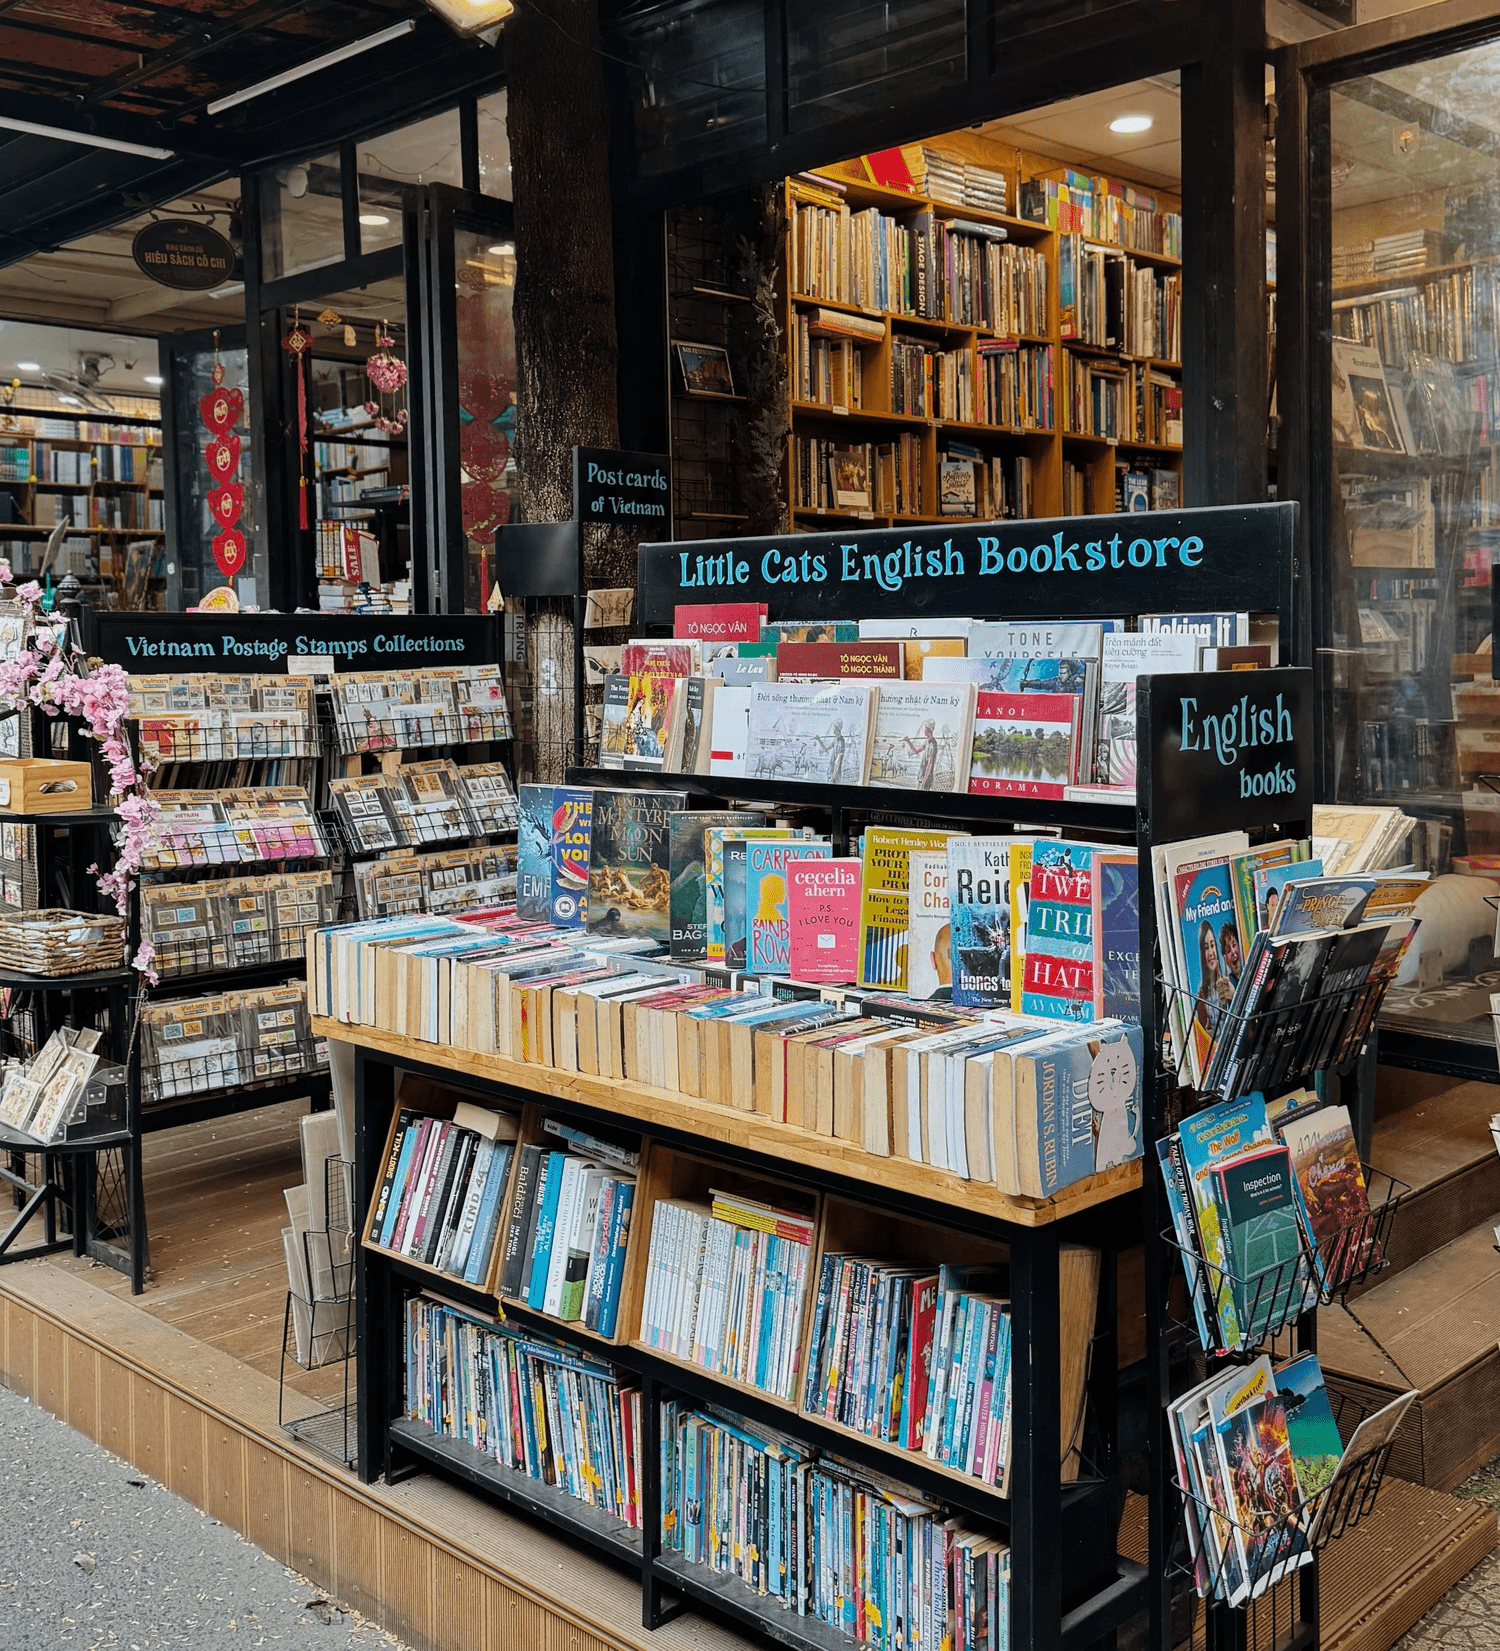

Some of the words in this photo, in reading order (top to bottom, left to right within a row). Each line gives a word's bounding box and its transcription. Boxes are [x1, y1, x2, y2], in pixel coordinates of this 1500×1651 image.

[917, 236, 926, 269] STAGE
[918, 271, 927, 311] DESIGN
[587, 462, 668, 491] Postcards
[591, 496, 605, 513] of
[608, 496, 666, 516] Vietnam
[346, 544, 360, 576] SALE
[679, 552, 750, 587] Little
[760, 548, 829, 584] Cats
[840, 539, 965, 592] English
[977, 531, 1204, 577] Bookstore
[516, 615, 525, 661] TRUNG
[687, 623, 699, 634] TÔ
[700, 624, 726, 634] NGỌC
[728, 621, 747, 633] VÂN
[1008, 632, 1053, 646] TONE
[1217, 617, 1231, 646] It
[125, 636, 216, 657] Vietnam
[222, 636, 288, 661] Postage
[295, 635, 368, 660] Stamps
[373, 634, 466, 653] Collections
[840, 653, 849, 663] TÔ
[850, 654, 872, 664] NGỌC
[873, 653, 888, 663] VÂN
[840, 664, 849, 673] TÔ
[850, 665, 872, 675] NGỌC
[873, 664, 896, 673] THÀNH
[930, 695, 948, 705] Nam
[1179, 692, 1294, 766] English
[1239, 762, 1297, 799] books
[563, 801, 592, 814] THE
[612, 796, 646, 808] VONDA
[611, 828, 663, 844] MOON
[873, 835, 898, 845] Robert
[901, 837, 928, 849] Henley
[618, 846, 653, 862] SUN
[871, 860, 903, 869] YOUR
[795, 868, 856, 885] cecelia
[805, 884, 846, 897] ahern
[869, 895, 890, 903] How
[893, 896, 903, 904] to
[805, 916, 830, 924] LOVE
[834, 916, 853, 927] YOU
[1186, 907, 1197, 923] My
[1197, 898, 1220, 918] Friend
[1072, 942, 1092, 964] of
[960, 970, 998, 991] bones
[1042, 1061, 1055, 1123] JORDAN
[1071, 1077, 1092, 1146] DIET
[1209, 1142, 1222, 1155] The
[1223, 1130, 1240, 1148] Wolf
[1044, 1138, 1057, 1189] RUBIN
[1171, 1144, 1181, 1167] TALES
[1176, 1167, 1183, 1177] OF
[1196, 1167, 1209, 1181] and
[1243, 1173, 1281, 1192] Inspection
[1308, 1157, 1347, 1187] Chance
[512, 1166, 529, 1218] Baldacci
[1178, 1177, 1186, 1192] THE
[374, 1185, 390, 1221] BOND
[462, 1192, 481, 1234] KIND
[474, 1169, 487, 1188] 44
[1180, 1192, 1192, 1219] TROJAN
[1186, 1219, 1195, 1234] WAR
[1221, 1217, 1233, 1254] Inspection
[505, 1237, 514, 1261] TODES
[511, 1237, 519, 1256] AUGE
[989, 1322, 997, 1352] IBBOTSON
[981, 1391, 989, 1419] MONSTER
[979, 1420, 988, 1446] MISSION
